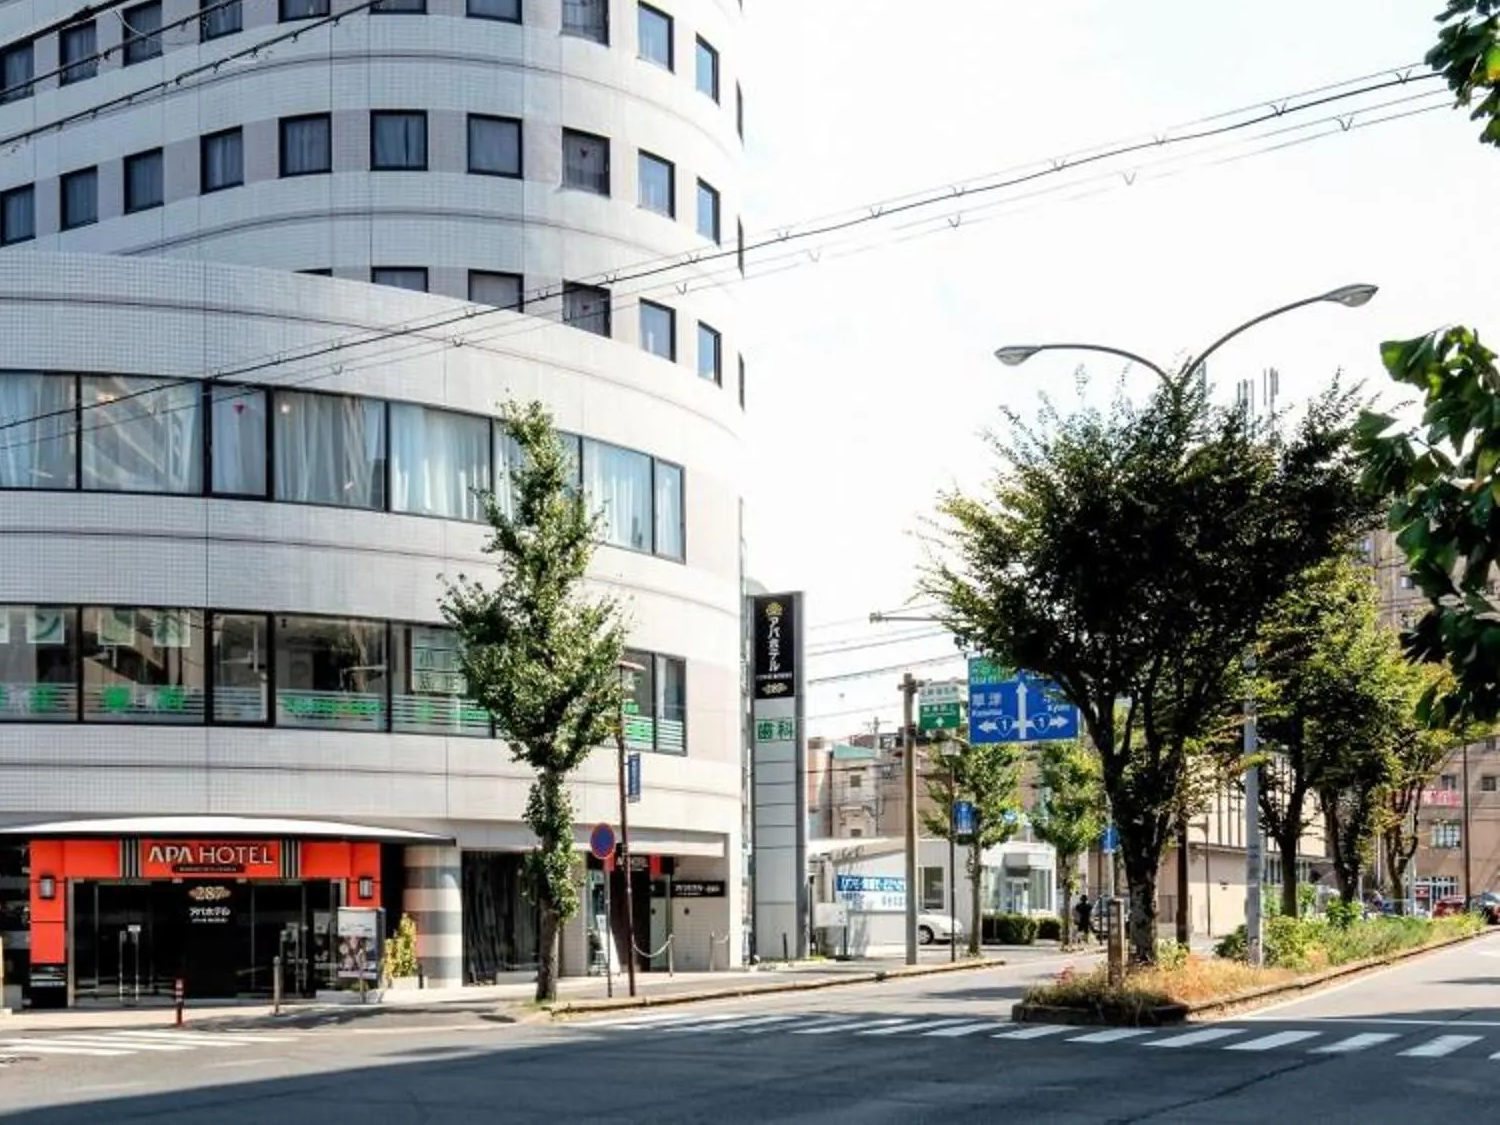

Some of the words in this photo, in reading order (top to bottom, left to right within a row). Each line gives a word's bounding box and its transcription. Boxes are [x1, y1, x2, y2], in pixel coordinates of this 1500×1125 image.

[757, 720, 793, 740] 歯科
[148, 845, 193, 864] APA
[199, 845, 274, 864] HOTEL
